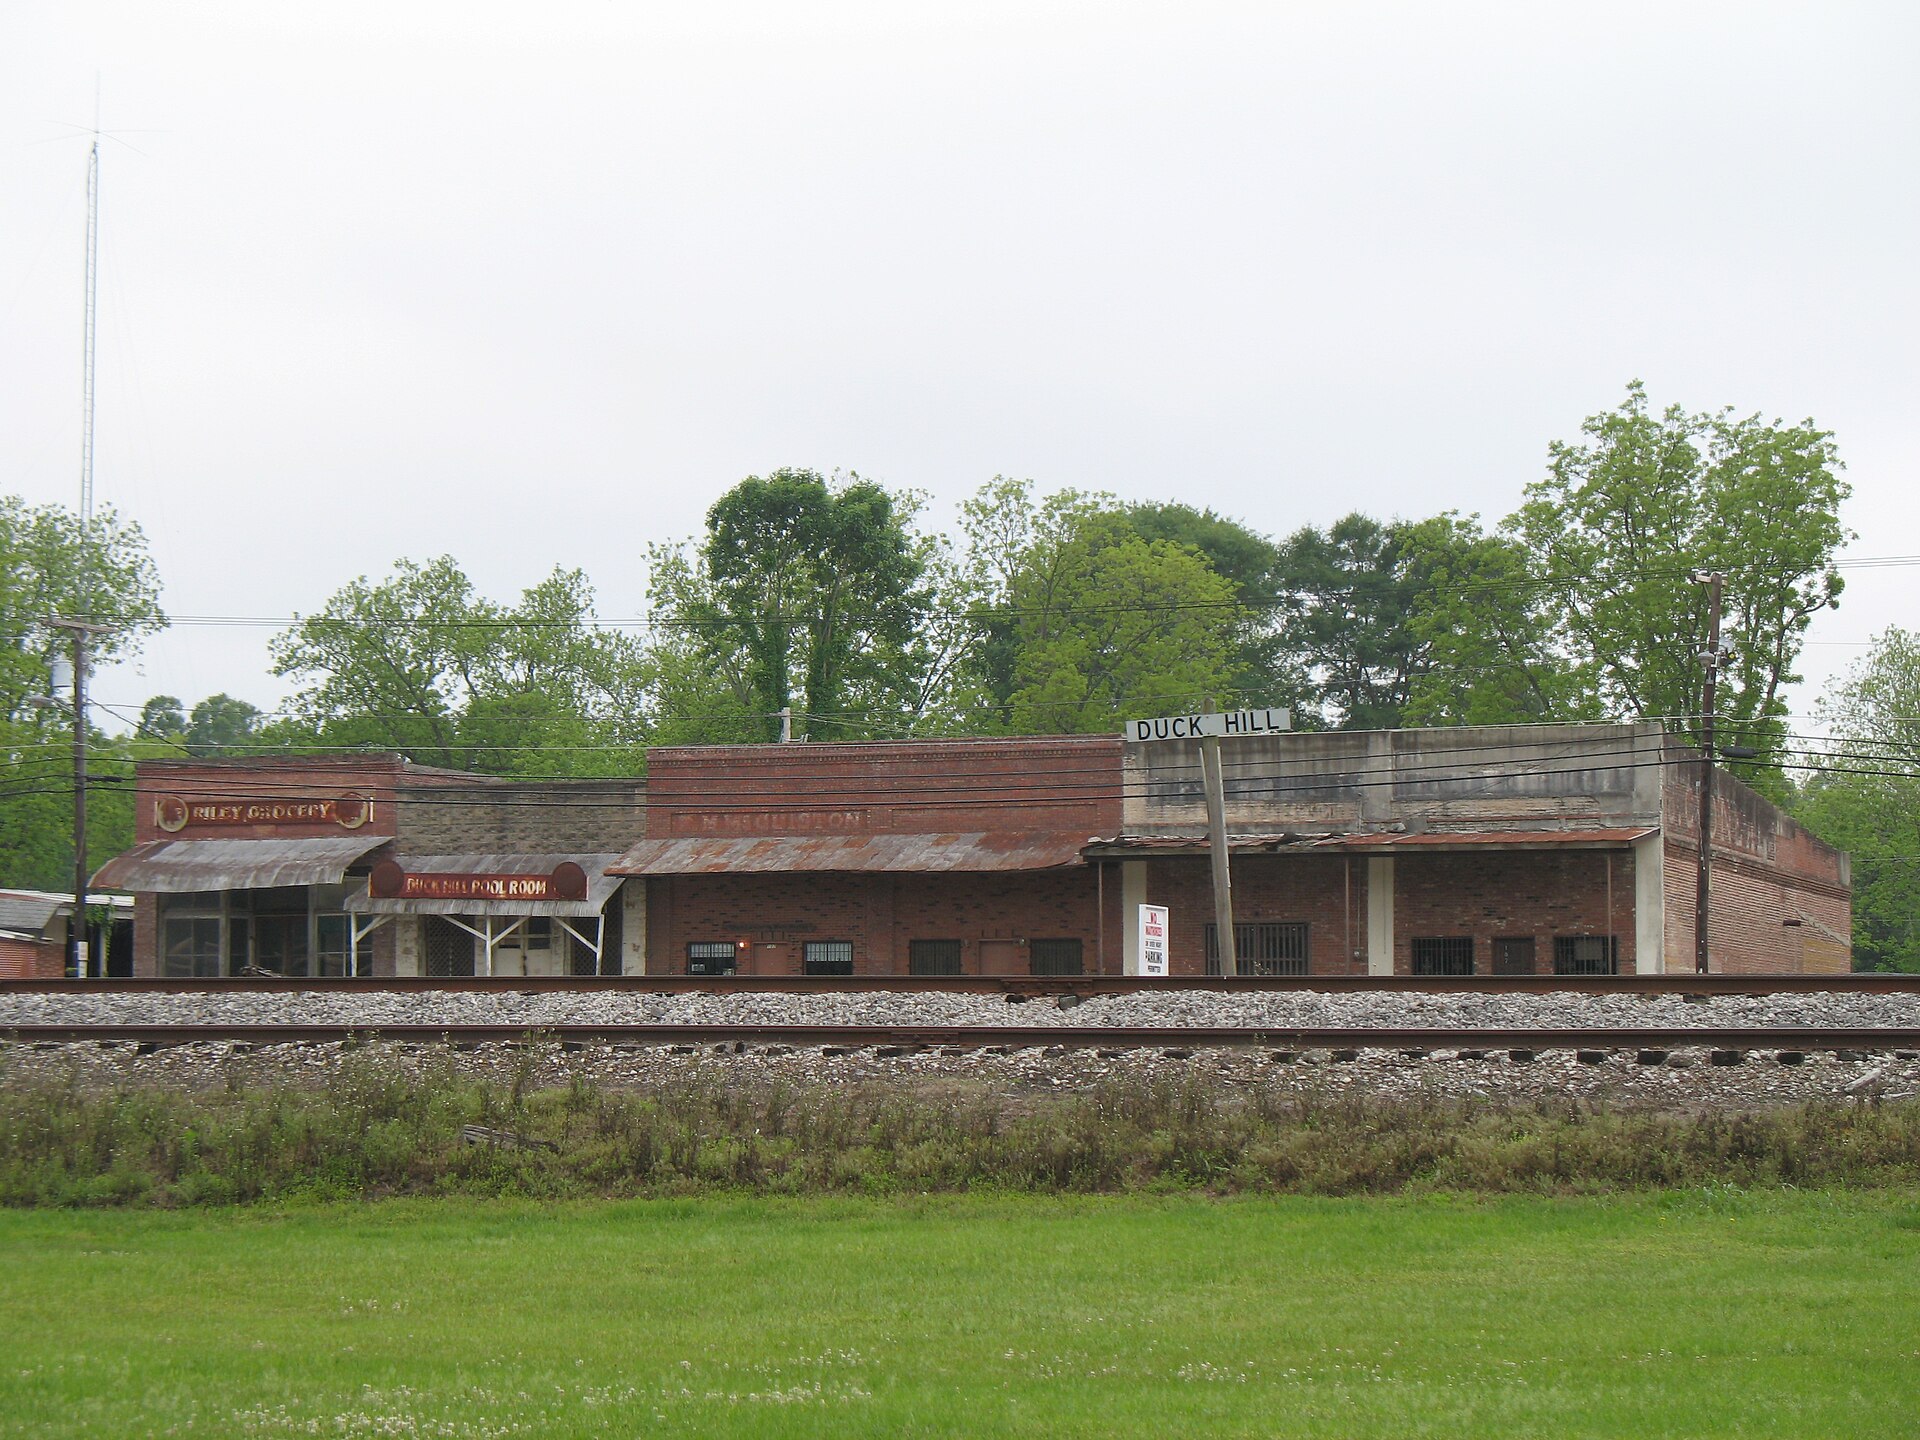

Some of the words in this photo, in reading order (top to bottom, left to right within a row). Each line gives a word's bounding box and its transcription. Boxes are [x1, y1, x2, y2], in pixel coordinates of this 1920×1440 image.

[1137, 716, 1203, 740] DUCK
[1225, 710, 1279, 733] HILL
[471, 879, 506, 895] POOL
[508, 880, 547, 895] ROOM
